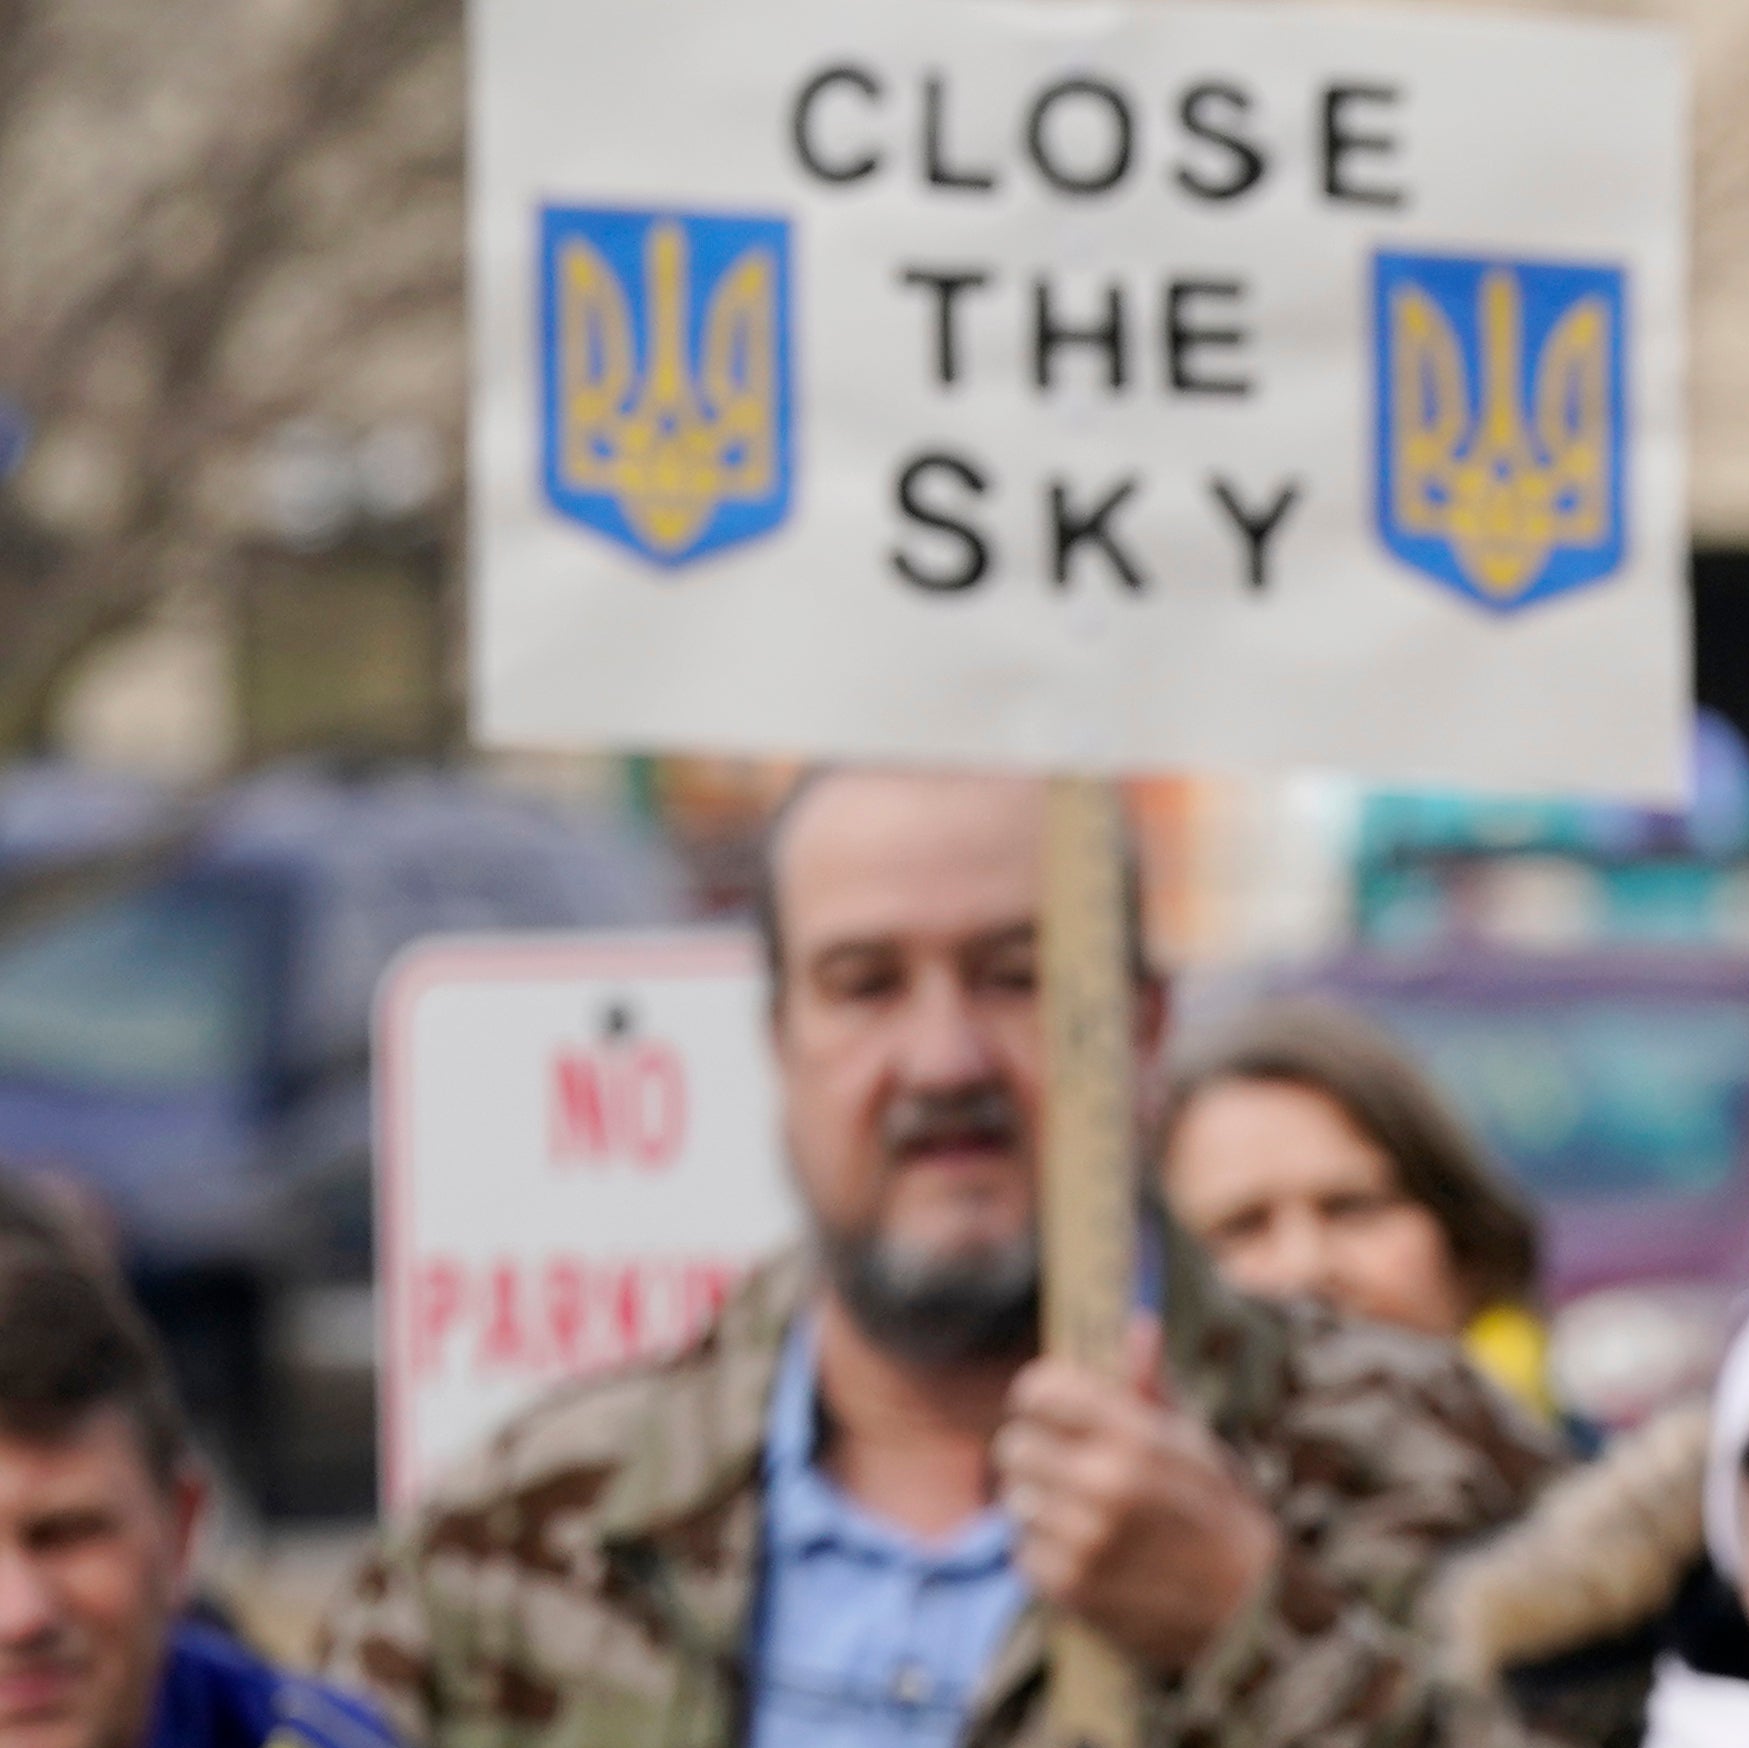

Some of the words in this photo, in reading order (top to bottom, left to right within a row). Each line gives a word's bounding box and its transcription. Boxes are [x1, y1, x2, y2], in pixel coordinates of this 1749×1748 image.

[790, 64, 1410, 204] CLOSE
[896, 264, 1254, 398] THE
[888, 452, 1306, 595] SKY
[550, 1040, 690, 1172] NO
